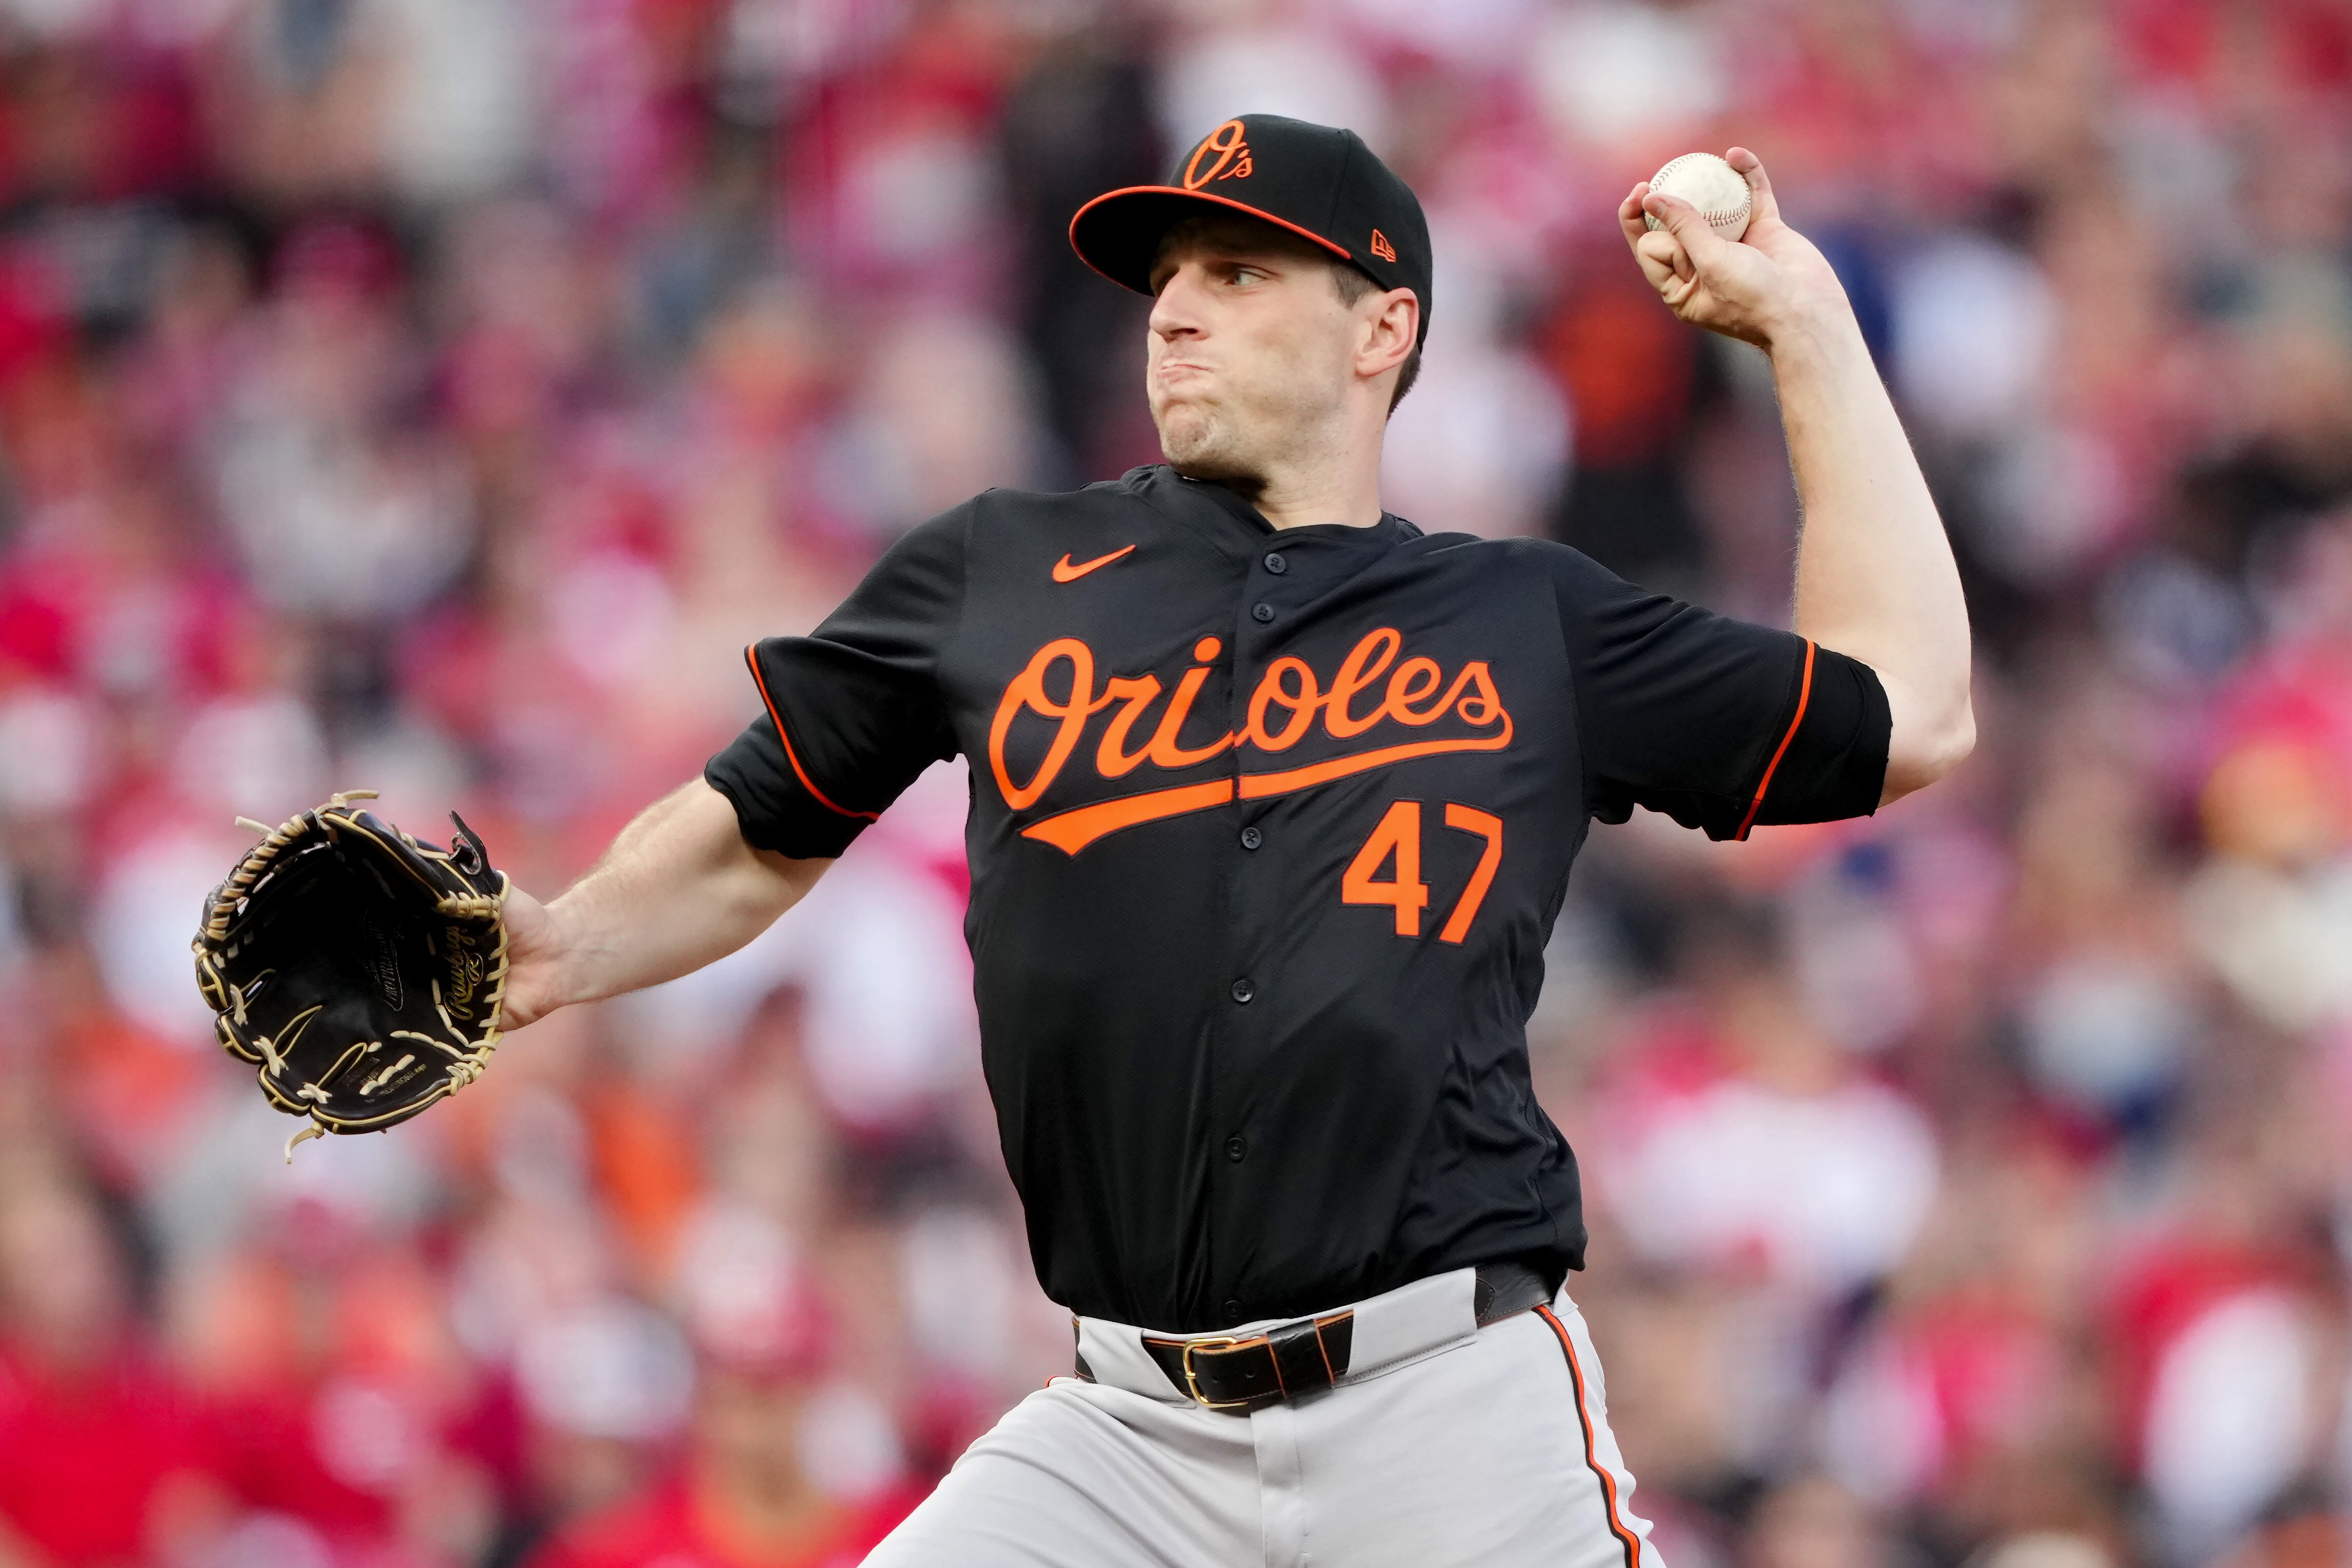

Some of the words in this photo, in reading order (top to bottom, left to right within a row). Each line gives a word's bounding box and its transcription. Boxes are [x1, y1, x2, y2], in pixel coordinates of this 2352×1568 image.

[1183, 120, 1253, 190] O's
[988, 627, 1514, 811] Orioles
[1341, 800, 1503, 944] 47
